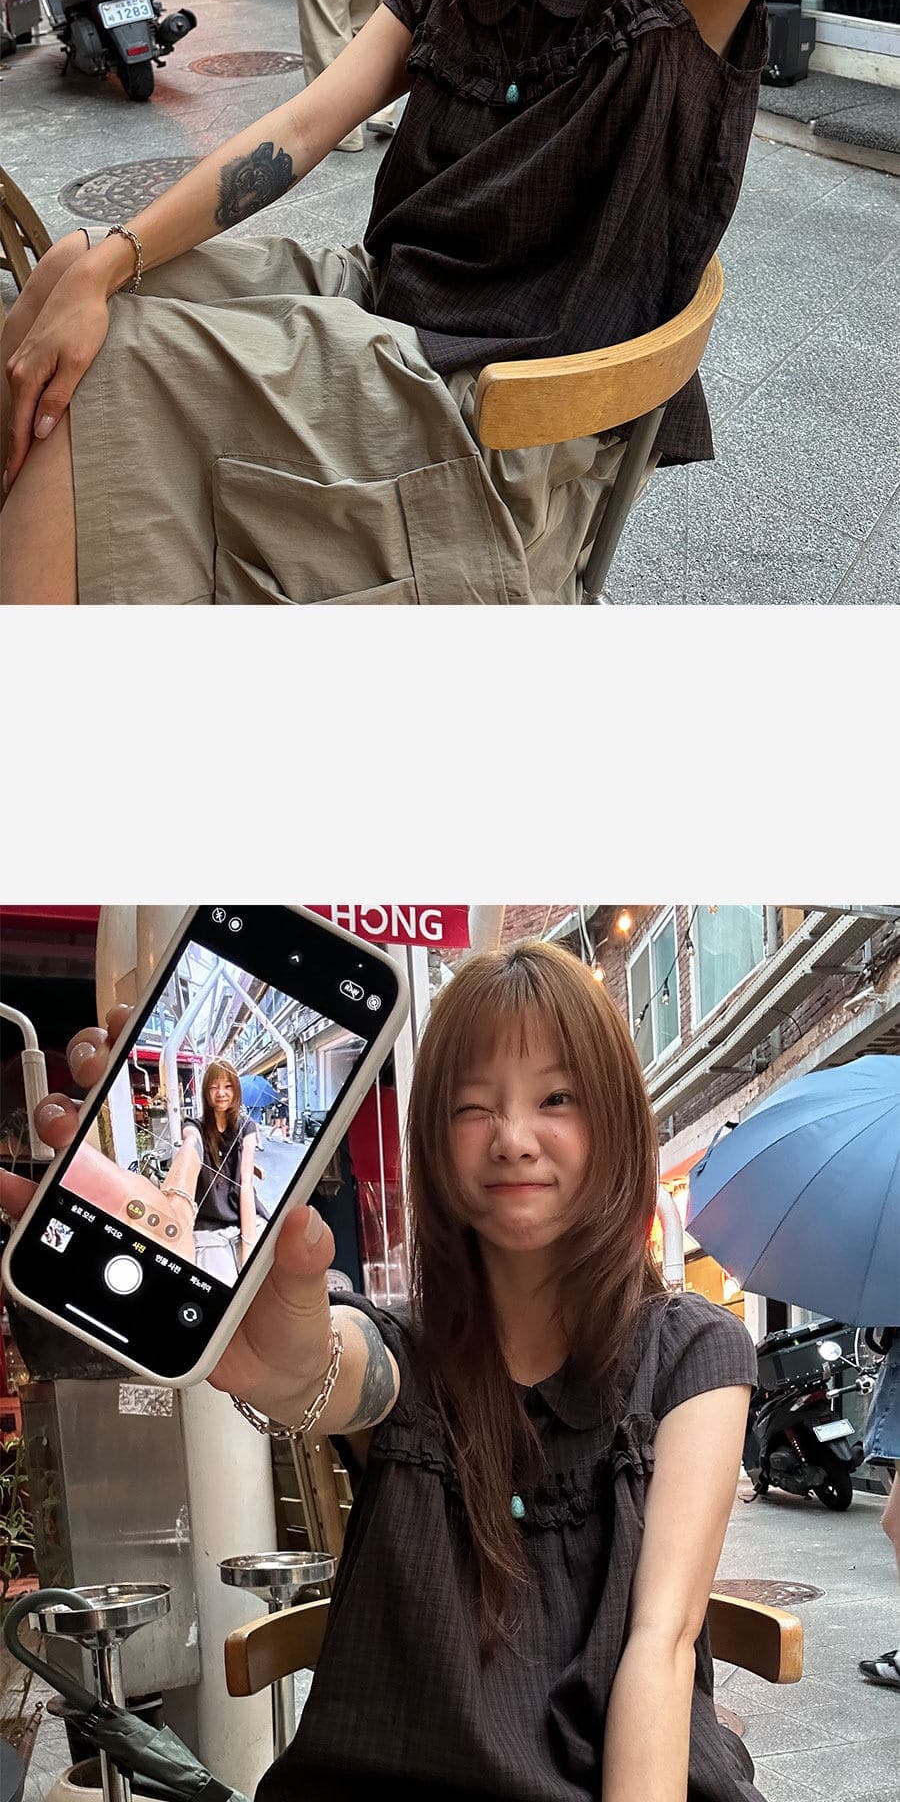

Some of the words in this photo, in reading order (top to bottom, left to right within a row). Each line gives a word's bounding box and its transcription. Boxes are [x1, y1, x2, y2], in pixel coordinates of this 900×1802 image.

[117, 4, 149, 21] 1283
[104, 1224, 123, 1240] 비디오
[132, 1241, 146, 1254] 사진
